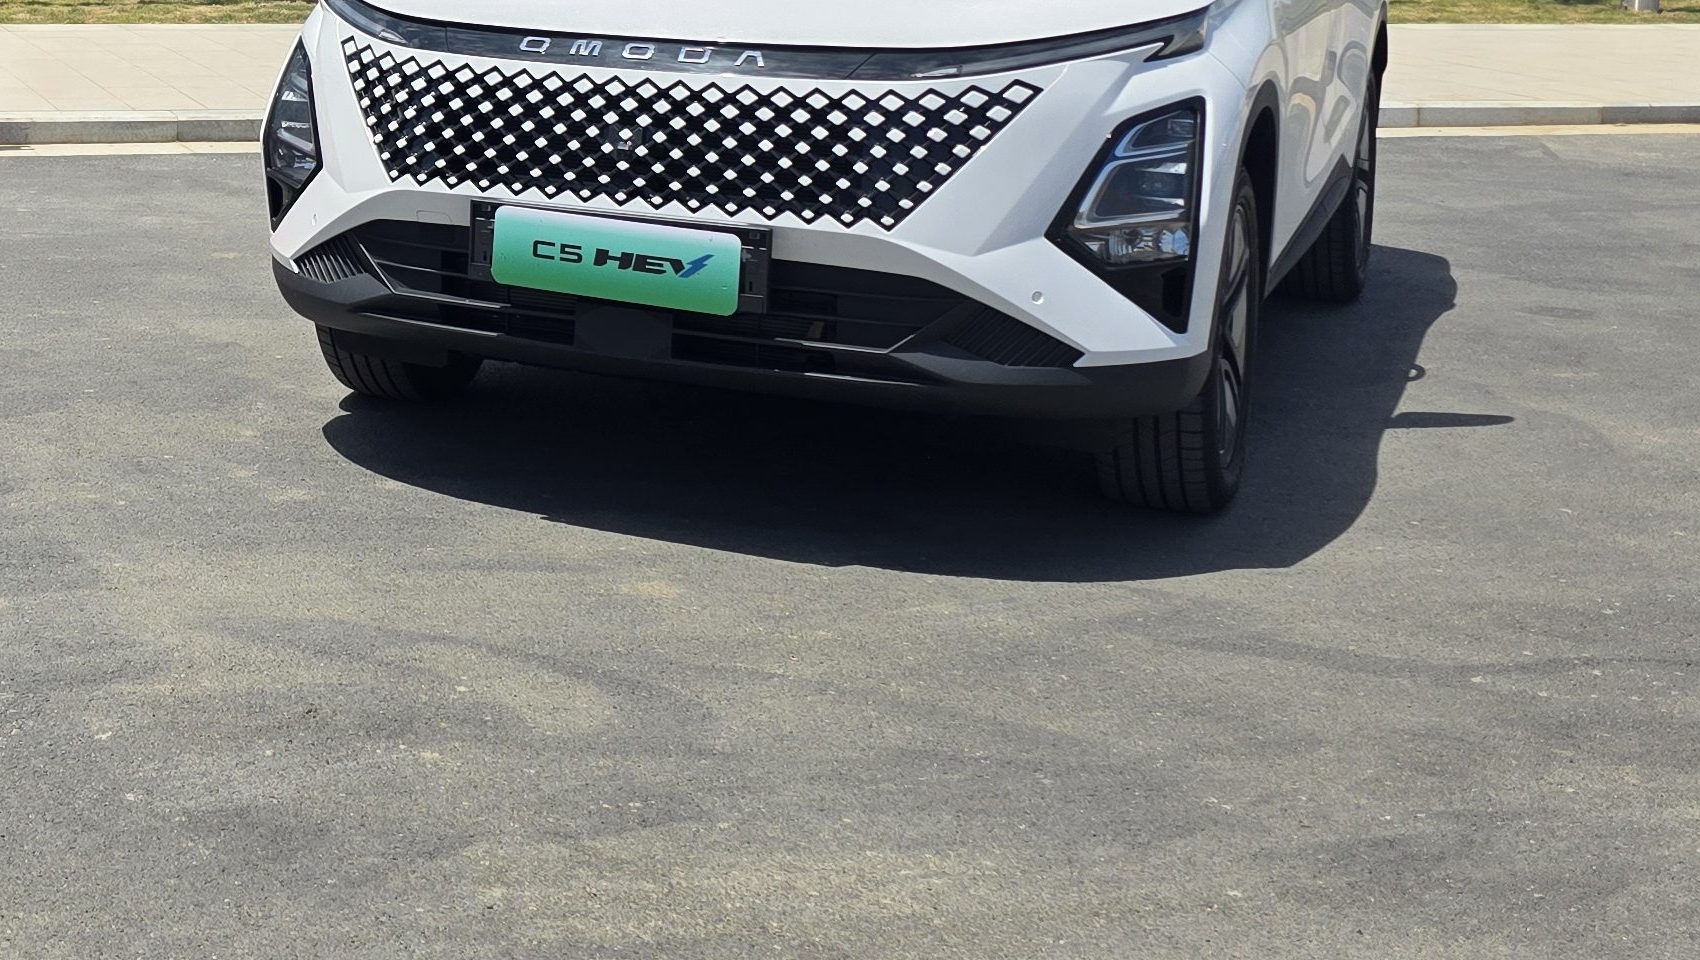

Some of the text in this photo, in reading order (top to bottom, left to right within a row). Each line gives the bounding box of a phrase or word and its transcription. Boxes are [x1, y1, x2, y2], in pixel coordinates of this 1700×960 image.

[519, 36, 765, 68] OMODA
[532, 240, 715, 279] C5 HEV
